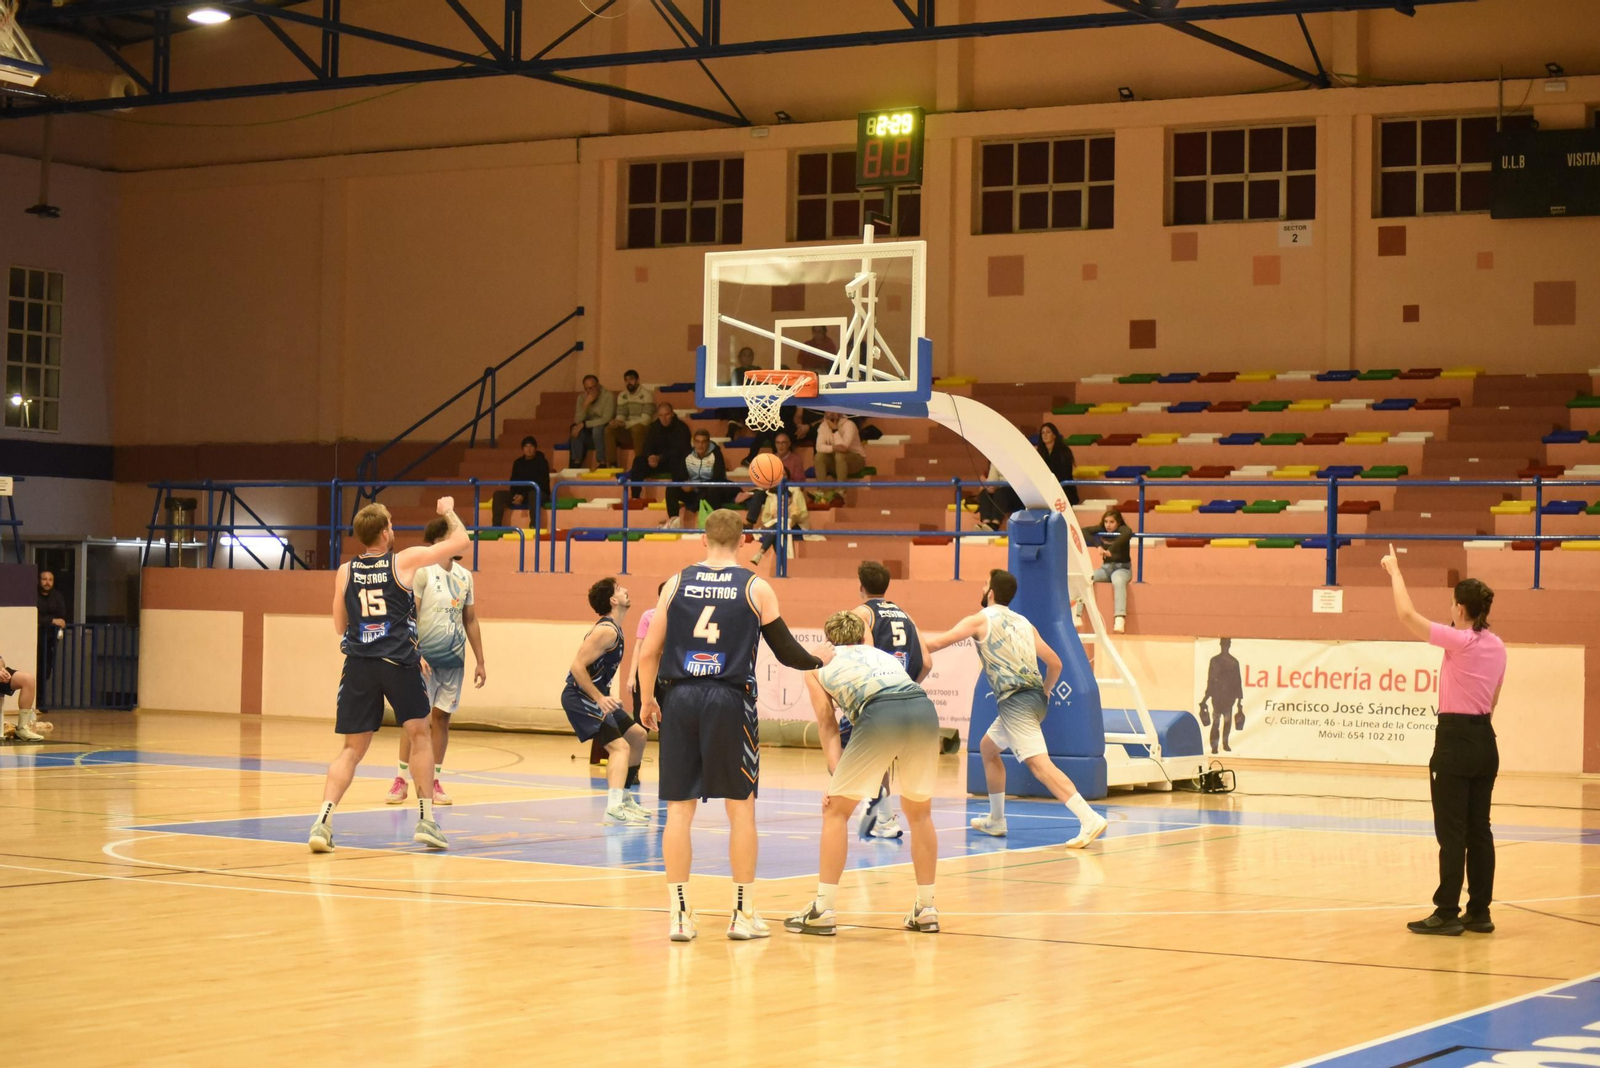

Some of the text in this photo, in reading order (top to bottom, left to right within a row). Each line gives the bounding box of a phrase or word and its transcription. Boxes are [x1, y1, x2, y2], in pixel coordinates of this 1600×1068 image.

[1502, 155, 1526, 169] U.L.B
[1292, 233, 1298, 243] 2
[366, 572, 388, 585] STROG
[696, 572, 733, 582] FURLAN
[705, 587, 738, 600] STROG
[358, 588, 388, 618] 15
[693, 605, 720, 645] 4
[812, 635, 823, 643] TU
[891, 621, 907, 647] 5
[767, 664, 777, 681] F
[1245, 664, 1438, 693] La Lechería de Di
[1265, 699, 1330, 713] Francisco
[1332, 701, 1364, 714] José
[1368, 702, 1427, 717] Sánchez
[1264, 716, 1278, 727] C/.
[1280, 716, 1321, 727] Gibraltar,
[1324, 718, 1336, 727] 46
[1342, 719, 1353, 728] La
[1382, 720, 1394, 729] de
[1396, 721, 1404, 730] la
[1347, 731, 1365, 740] 654
[1368, 732, 1385, 741] 102
[1387, 732, 1405, 741] 210
